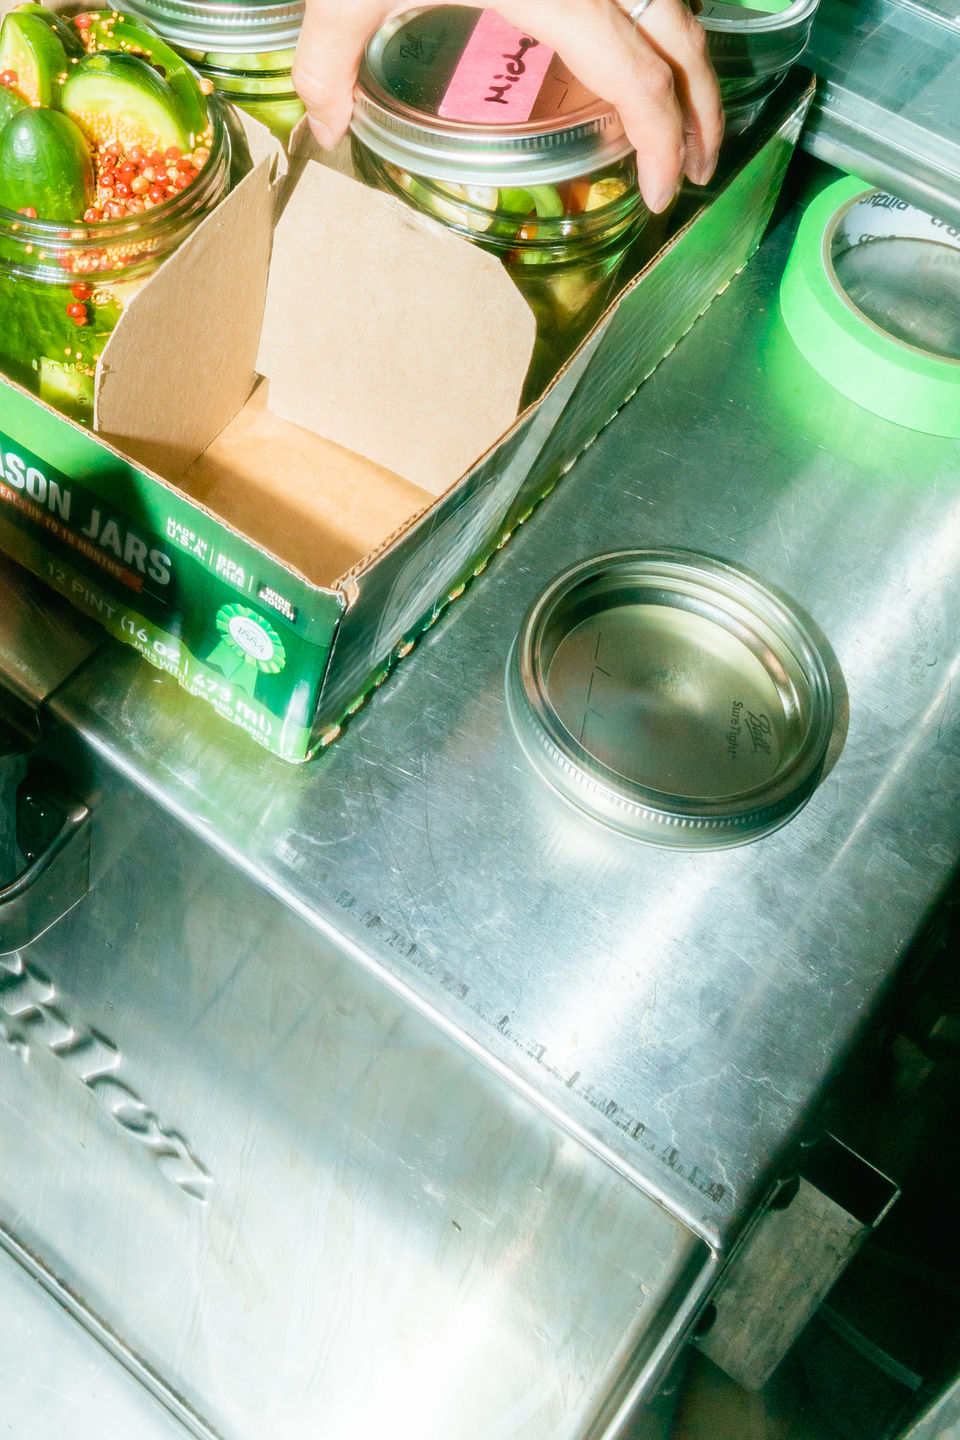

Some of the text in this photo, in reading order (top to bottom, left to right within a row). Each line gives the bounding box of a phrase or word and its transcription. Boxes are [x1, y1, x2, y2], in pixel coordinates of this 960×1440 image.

[80, 508, 172, 586] JARS
[166, 528, 206, 561] U.S.A.
[167, 517, 208, 551] MADE IN
[216, 564, 245, 587] FREE
[217, 553, 245, 579] BPA
[71, 582, 116, 619] PINT
[120, 615, 148, 642] (16
[259, 591, 295, 621] MOUTH
[265, 586, 292, 609] WIDE
